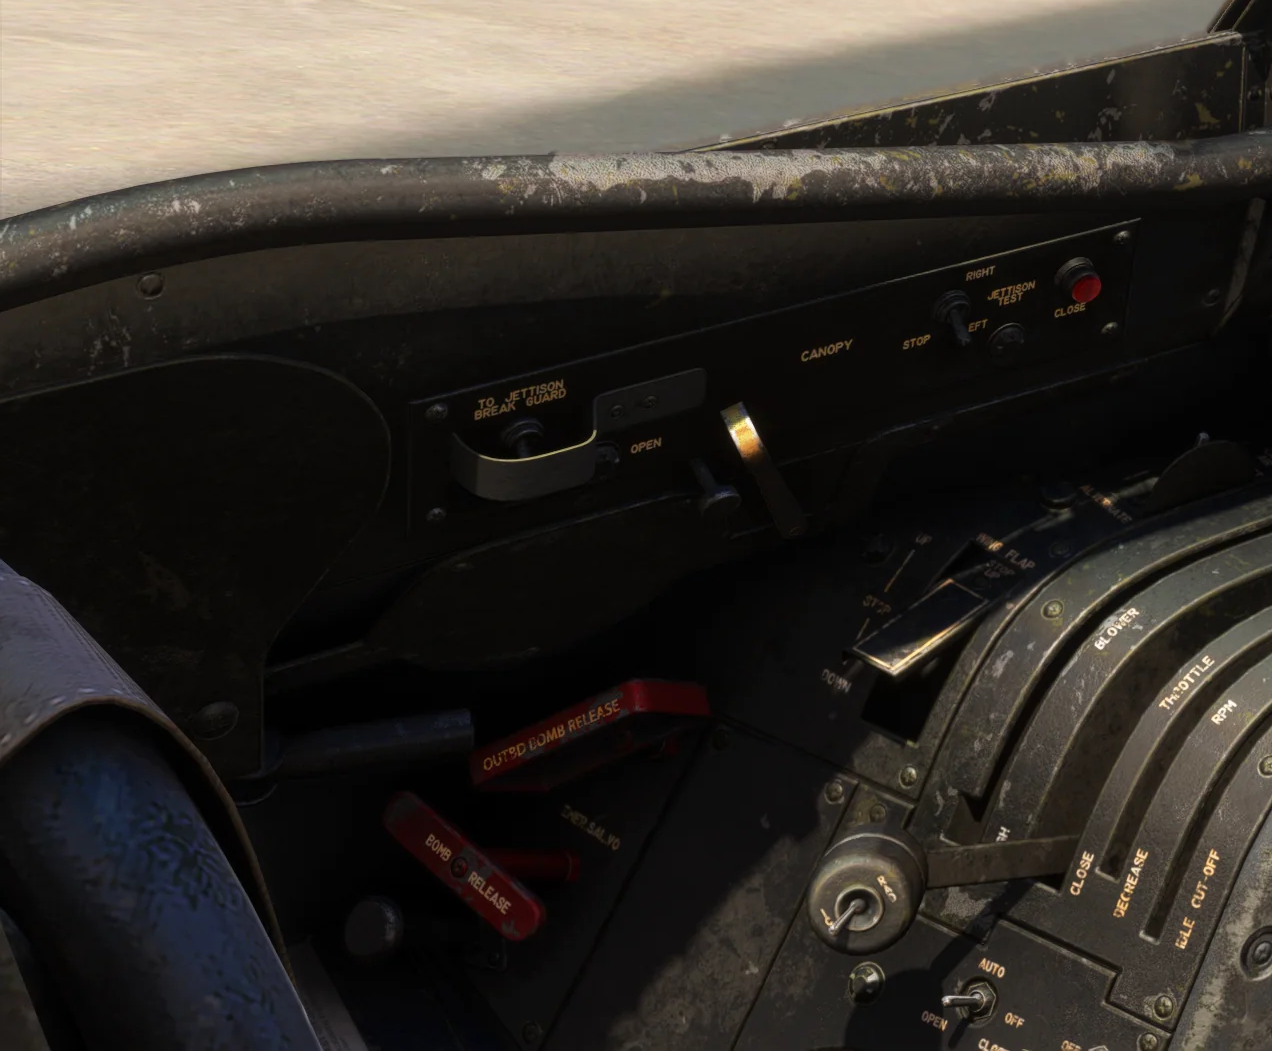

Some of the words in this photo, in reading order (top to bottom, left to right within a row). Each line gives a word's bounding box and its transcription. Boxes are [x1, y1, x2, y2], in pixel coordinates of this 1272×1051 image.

[965, 265, 996, 281] RIGHT
[987, 280, 1037, 301] JETTISON
[998, 291, 1025, 307] TEST
[1053, 301, 1087, 318] CLOSE
[800, 338, 853, 362] CANOPY
[902, 334, 932, 351] STOP
[473, 401, 517, 421] BREAK
[525, 387, 567, 408] GUARD
[478, 397, 495, 410] TO
[504, 378, 565, 404] JETTISON
[630, 436, 662, 455] OPEN
[1004, 549, 1036, 571] FLAP
[1094, 607, 1140, 651] BLOWER
[820, 667, 852, 694] DOWN
[1211, 699, 1238, 726] RPM
[482, 741, 527, 773] OUTBD
[528, 723, 567, 752] BOMB
[567, 698, 622, 732] RELEASE
[425, 832, 453, 863] BOMB
[467, 871, 512, 917] RELEASE
[1070, 851, 1095, 896] CLOSE
[1113, 848, 1149, 919] DECREASE
[1175, 916, 1196, 950] IDLE
[1191, 848, 1221, 910] CUT-OFF
[978, 957, 1006, 978] AUTO
[921, 1010, 948, 1032] OPEN
[1004, 1012, 1025, 1029] OFF
